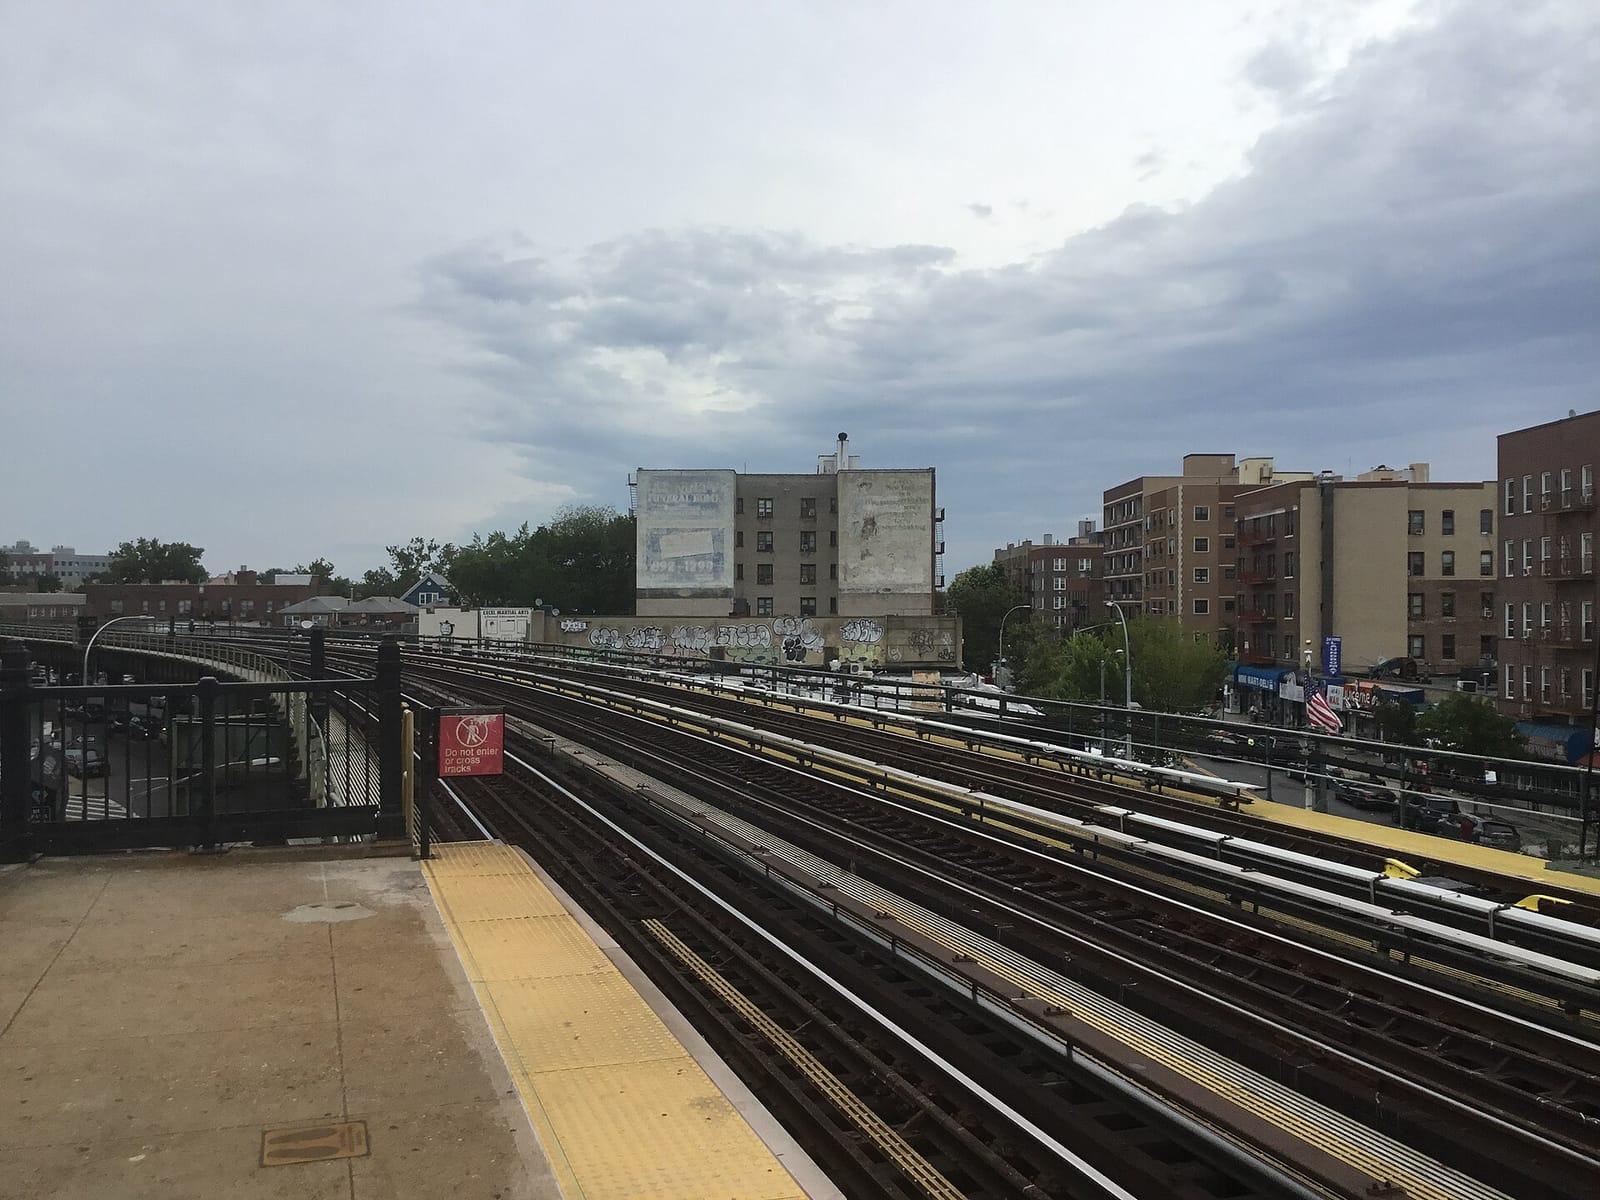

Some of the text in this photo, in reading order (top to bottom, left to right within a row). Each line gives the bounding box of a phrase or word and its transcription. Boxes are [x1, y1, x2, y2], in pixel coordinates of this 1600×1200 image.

[445, 748, 498, 757] Do not enter
[444, 765, 472, 773] tracks
